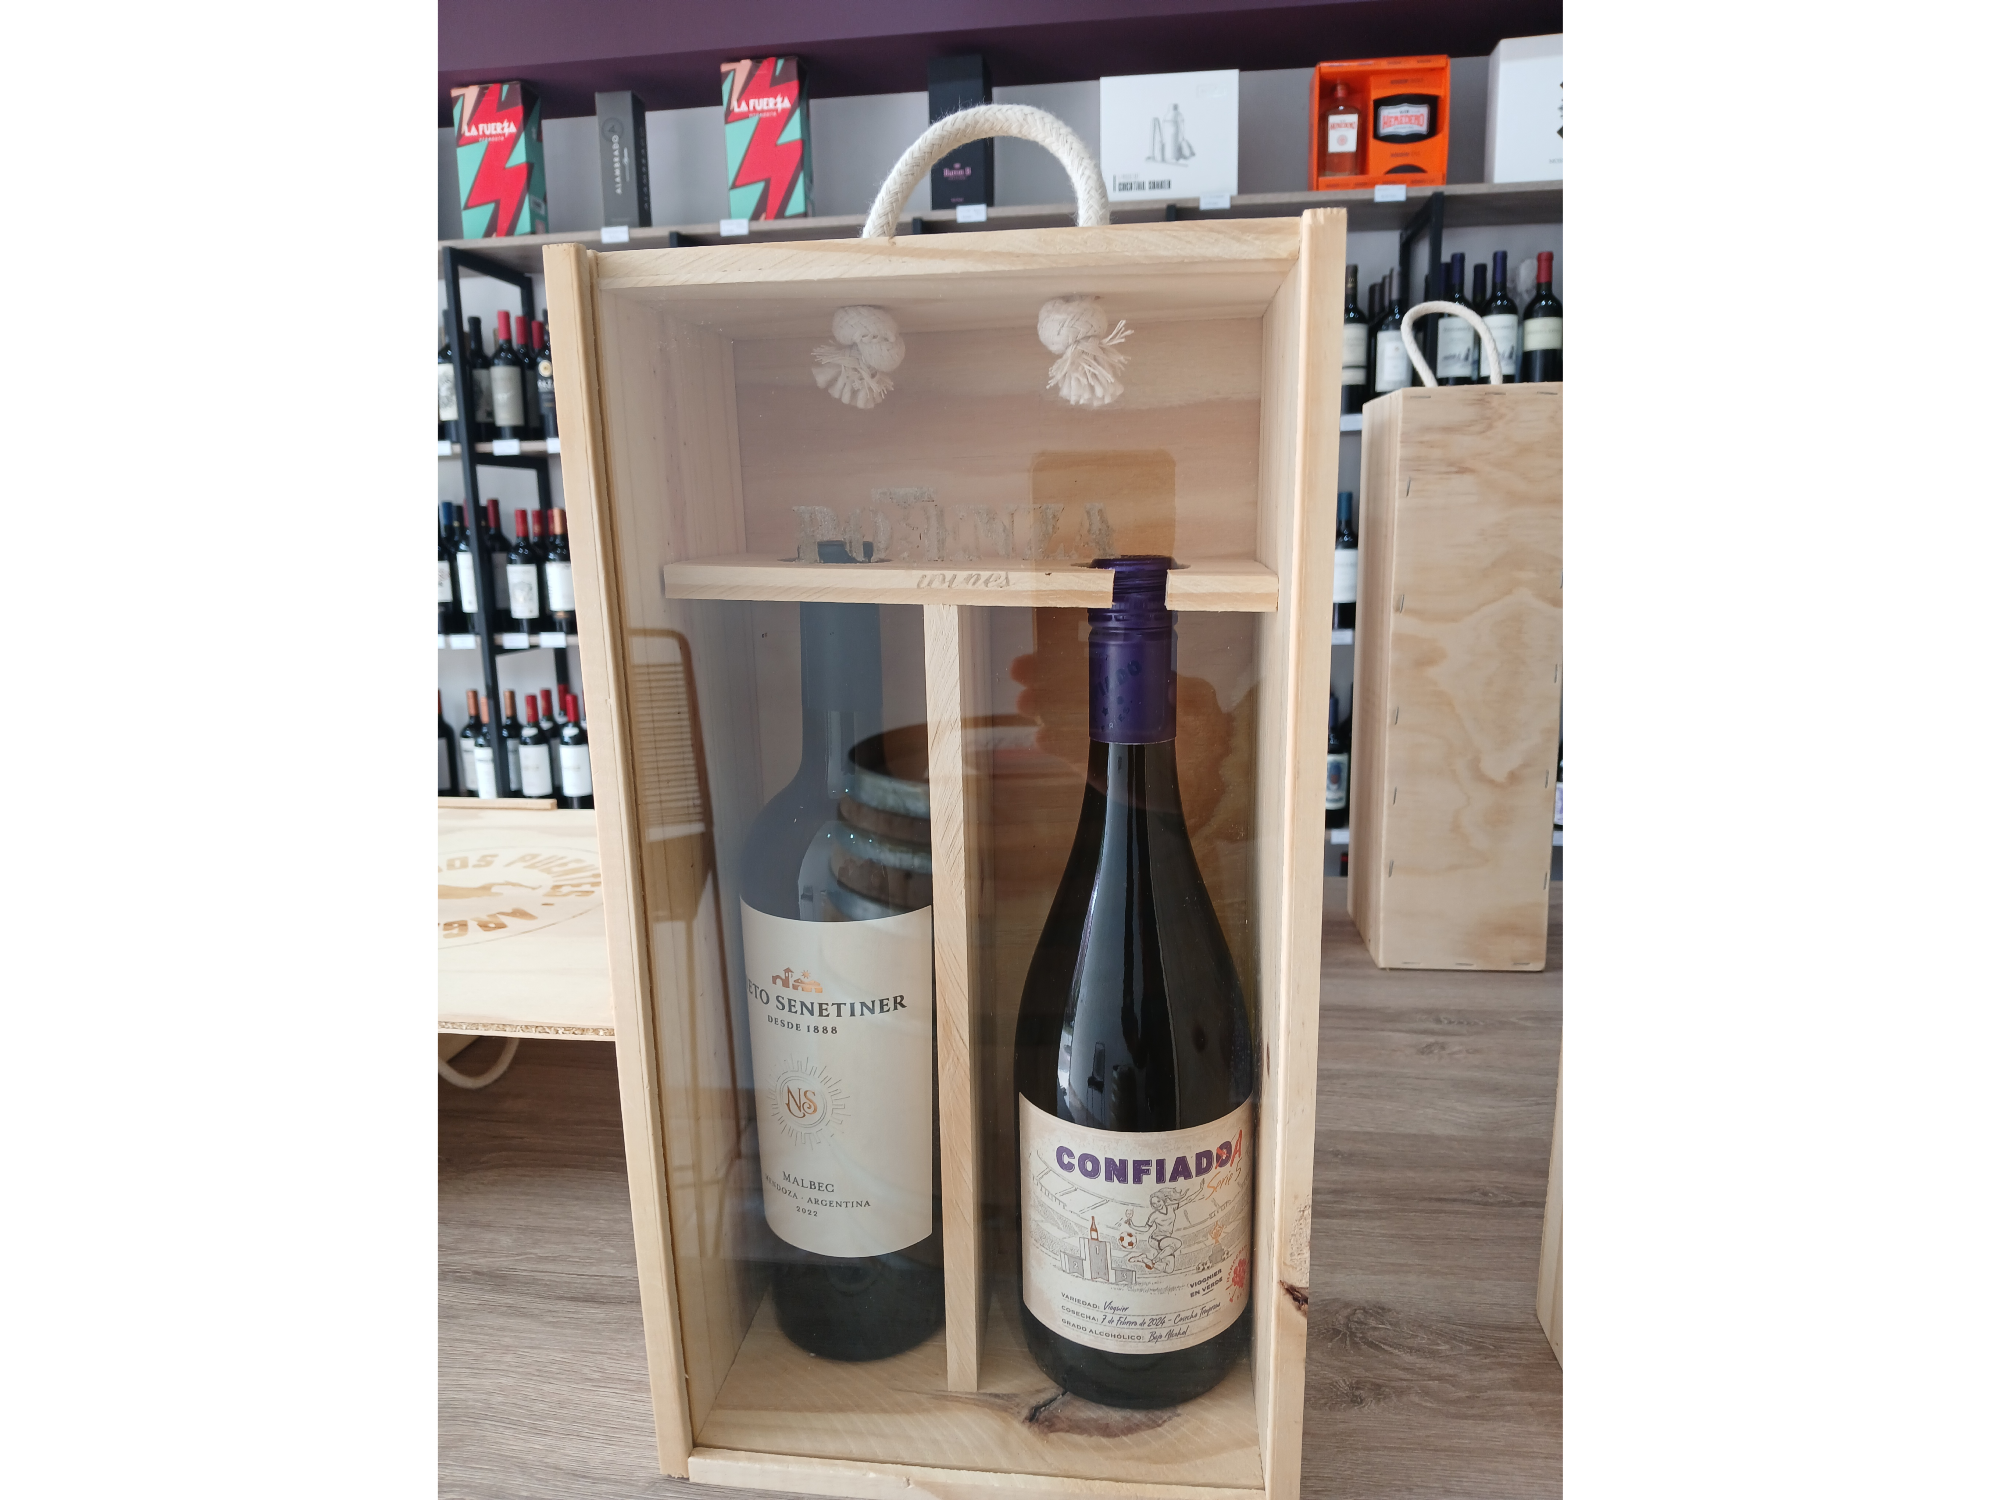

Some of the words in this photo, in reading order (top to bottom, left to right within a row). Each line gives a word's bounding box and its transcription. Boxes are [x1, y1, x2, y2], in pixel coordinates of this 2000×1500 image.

[733, 99, 748, 112] LA
[749, 92, 791, 113] FUERZA
[464, 124, 478, 136] LA
[478, 119, 517, 138] FUERZA
[612, 134, 622, 195] ALAMBRADO
[775, 994, 908, 1018] SENETINER
[767, 1014, 801, 1032] DESDE
[807, 1024, 838, 1035] 1888
[782, 1171, 835, 1193] MALBEC
[796, 1205, 819, 1218] 2022
[806, 1196, 872, 1209] ARGENTINA
[1189, 1268, 1222, 1288] VIOGNIER
[1190, 1289, 1201, 1298] EN
[1202, 1276, 1223, 1292] VERDE
[1061, 1292, 1100, 1310] VARIEDAD:
[1061, 1305, 1099, 1322] COSECHA:
[1101, 1314, 1107, 1324] 7
[1108, 1316, 1115, 1325] de
[1116, 1316, 1138, 1327] Febrero
[1139, 1318, 1147, 1327] de
[1147, 1316, 1167, 1328] 2024
[1061, 1318, 1087, 1332] GRADO
